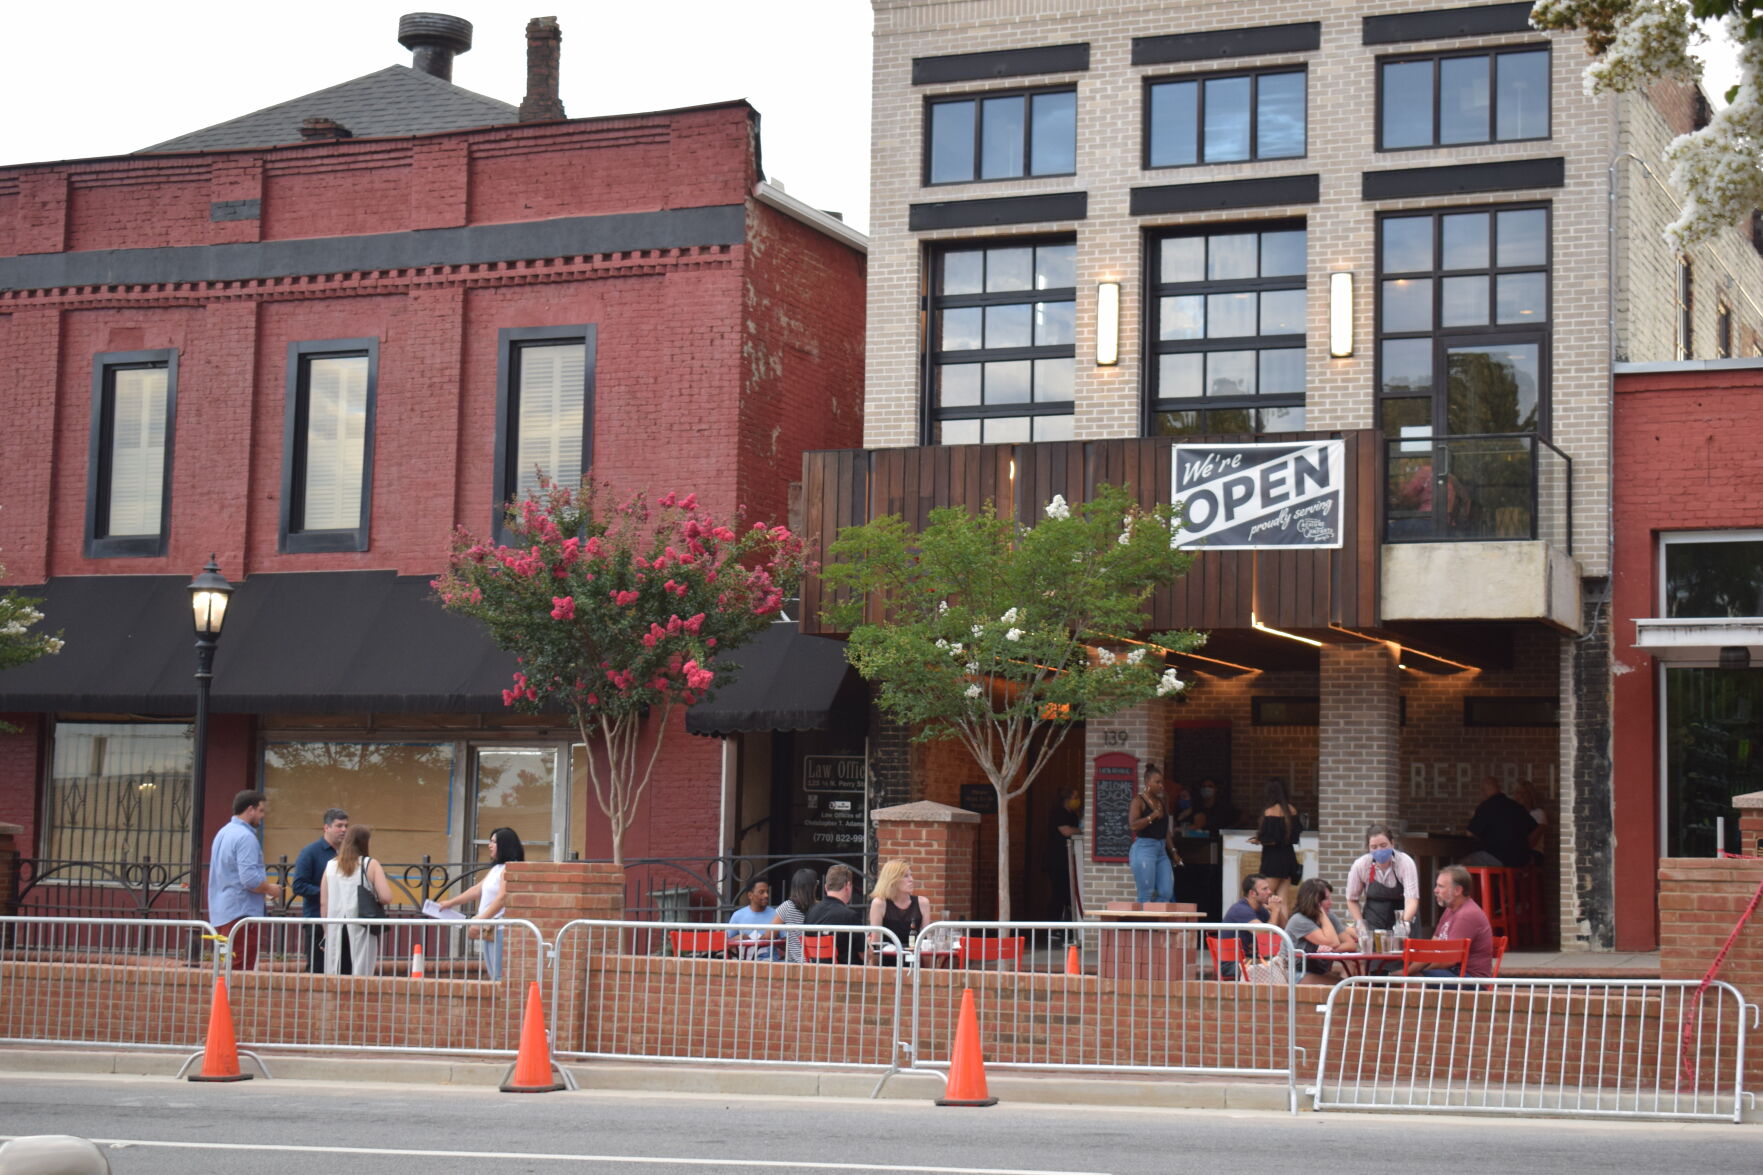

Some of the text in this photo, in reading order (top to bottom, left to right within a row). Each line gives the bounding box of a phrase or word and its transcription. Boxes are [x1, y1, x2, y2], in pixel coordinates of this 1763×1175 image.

[1183, 453, 1242, 486] We're
[1184, 446, 1330, 534] OPEN
[1248, 499, 1333, 541] proudly serving
[1104, 730, 1128, 746] 139
[808, 760, 832, 778] Law
[813, 832, 834, 843] (770)
